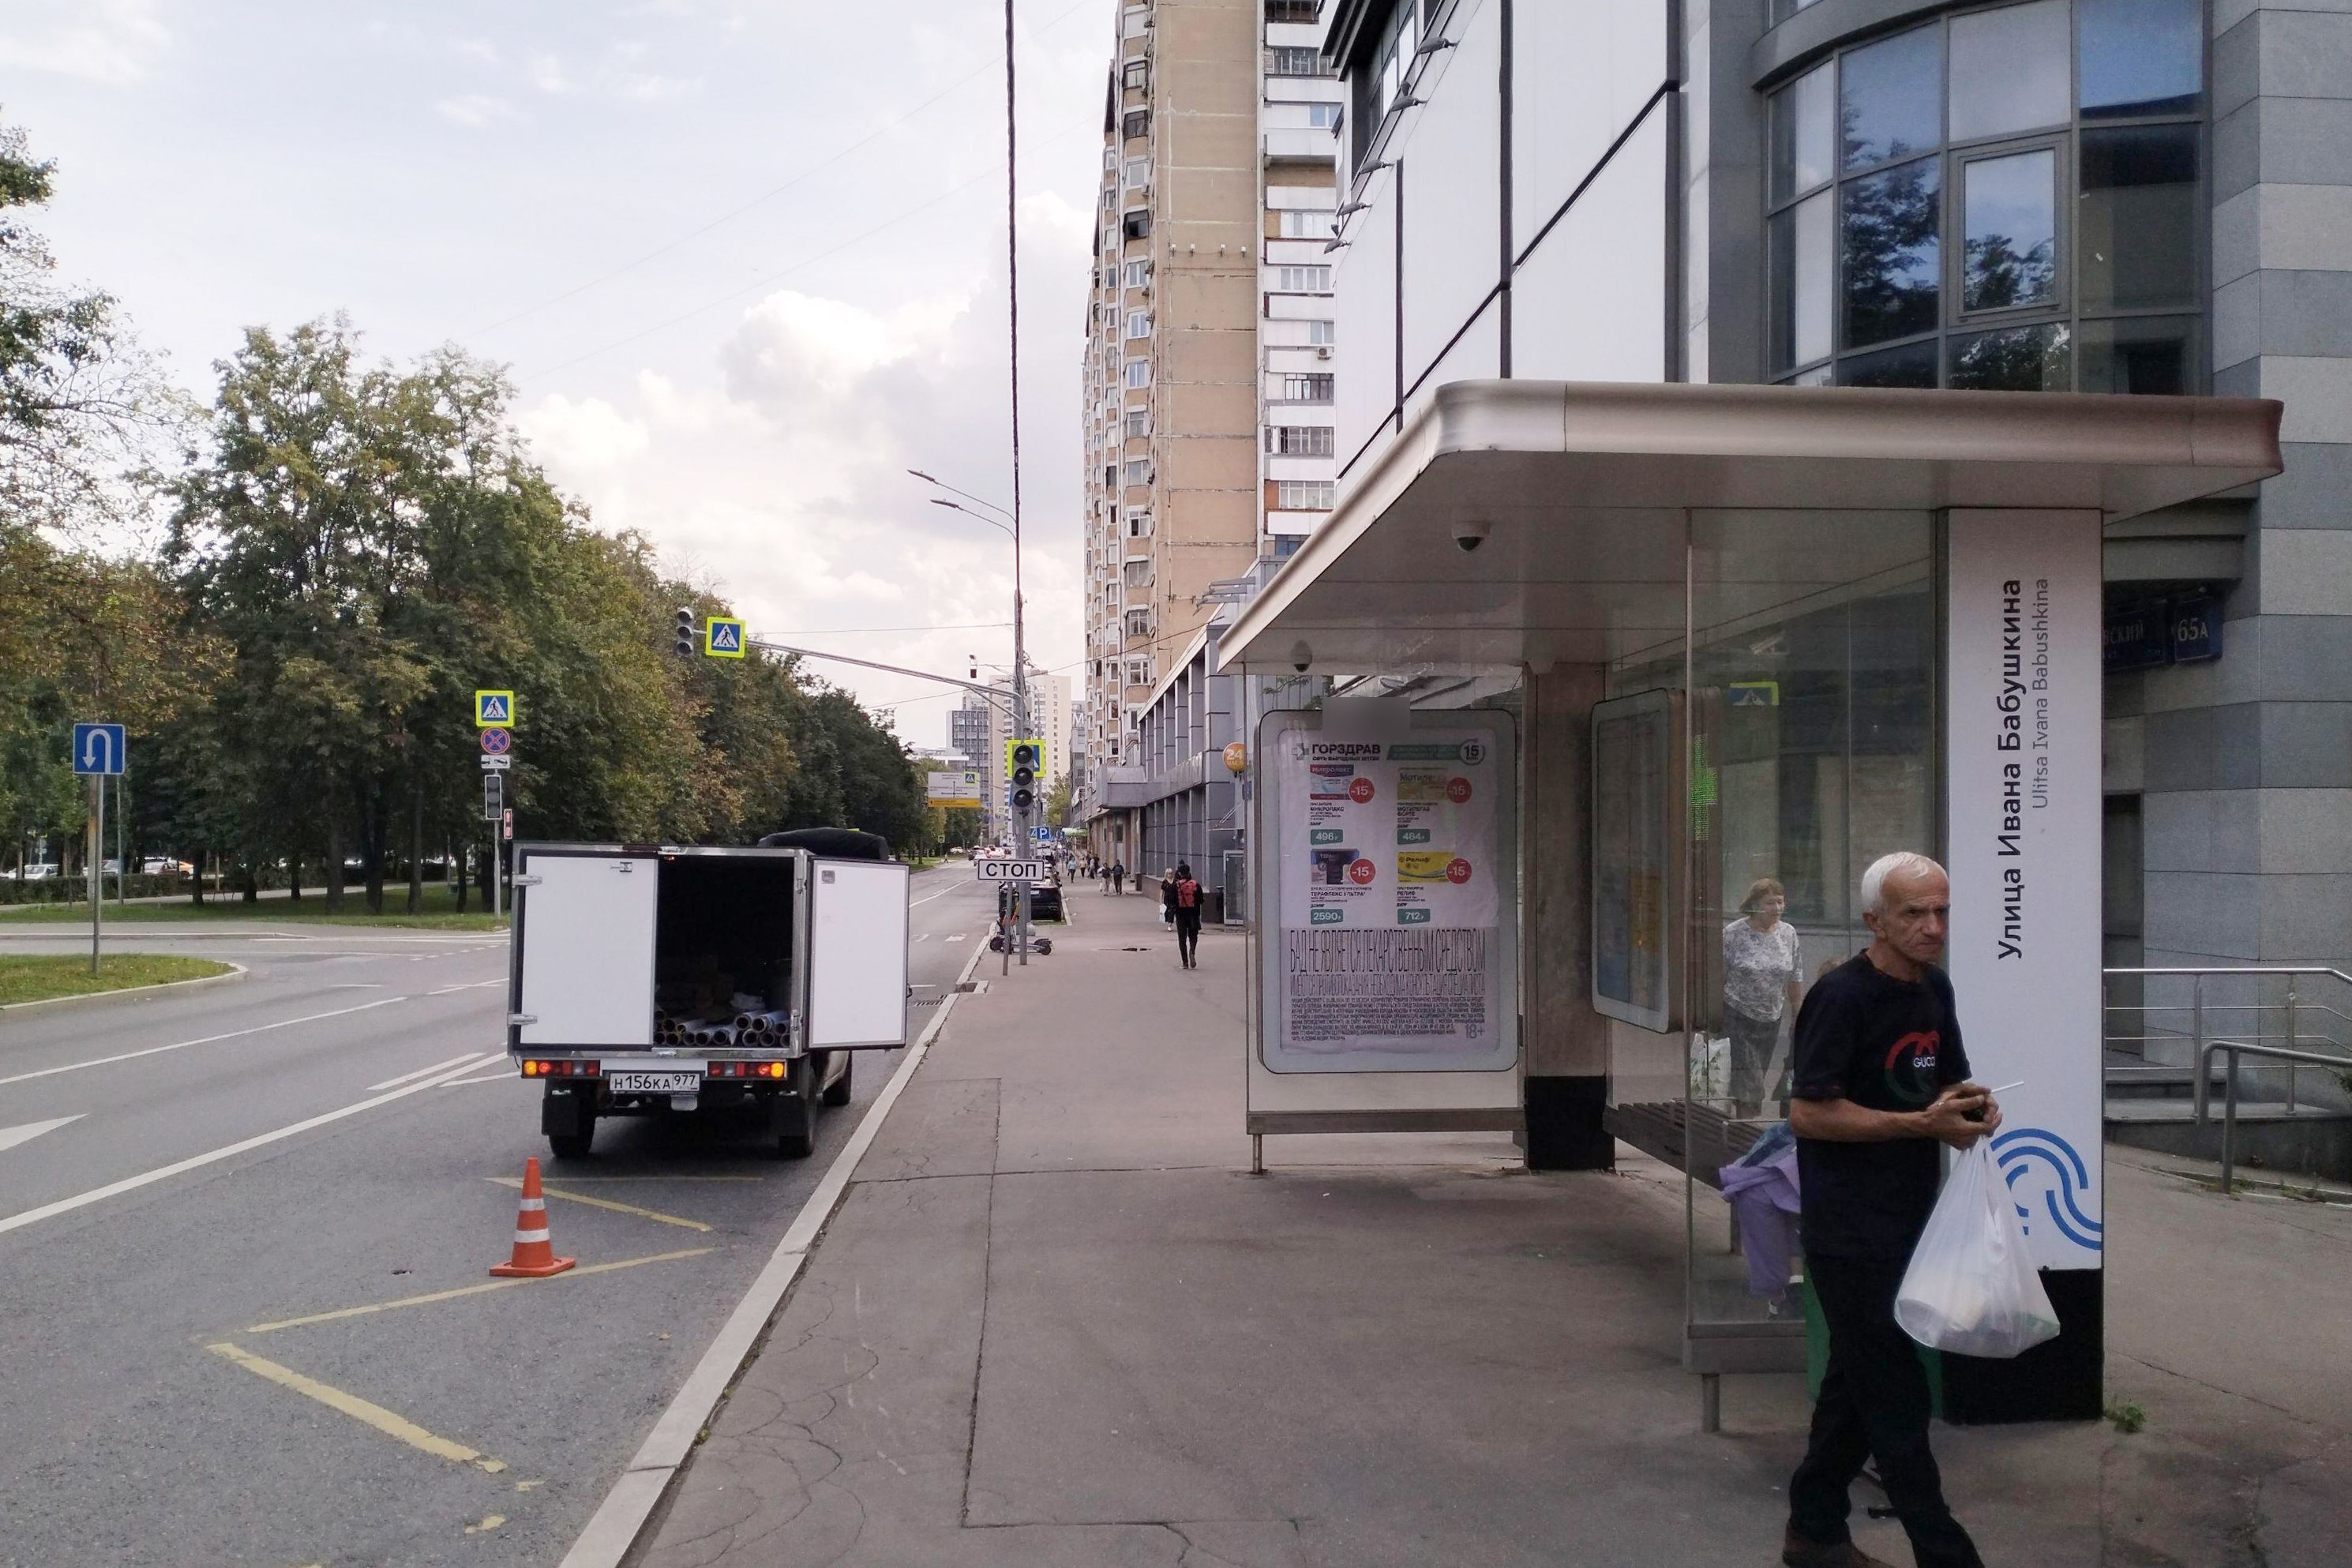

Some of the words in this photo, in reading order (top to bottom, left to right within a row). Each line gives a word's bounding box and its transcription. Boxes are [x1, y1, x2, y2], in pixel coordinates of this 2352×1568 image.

[2032, 578, 2048, 691] Babushkina
[1996, 579, 2027, 751] Бабушкина
[2033, 698, 2048, 749] Ivana
[1227, 749, 1243, 759] 24
[1312, 744, 1381, 756] ГОРЗДРАВ
[1464, 745, 1479, 756] 15
[2033, 756, 2048, 809] Ulitsa
[1351, 786, 1368, 795] -15
[1998, 763, 2021, 856] Ивана
[986, 863, 1036, 877] СТОП
[1352, 867, 1369, 877] -15
[1998, 869, 2025, 960] Улица
[1466, 1024, 1485, 1039] 18+
